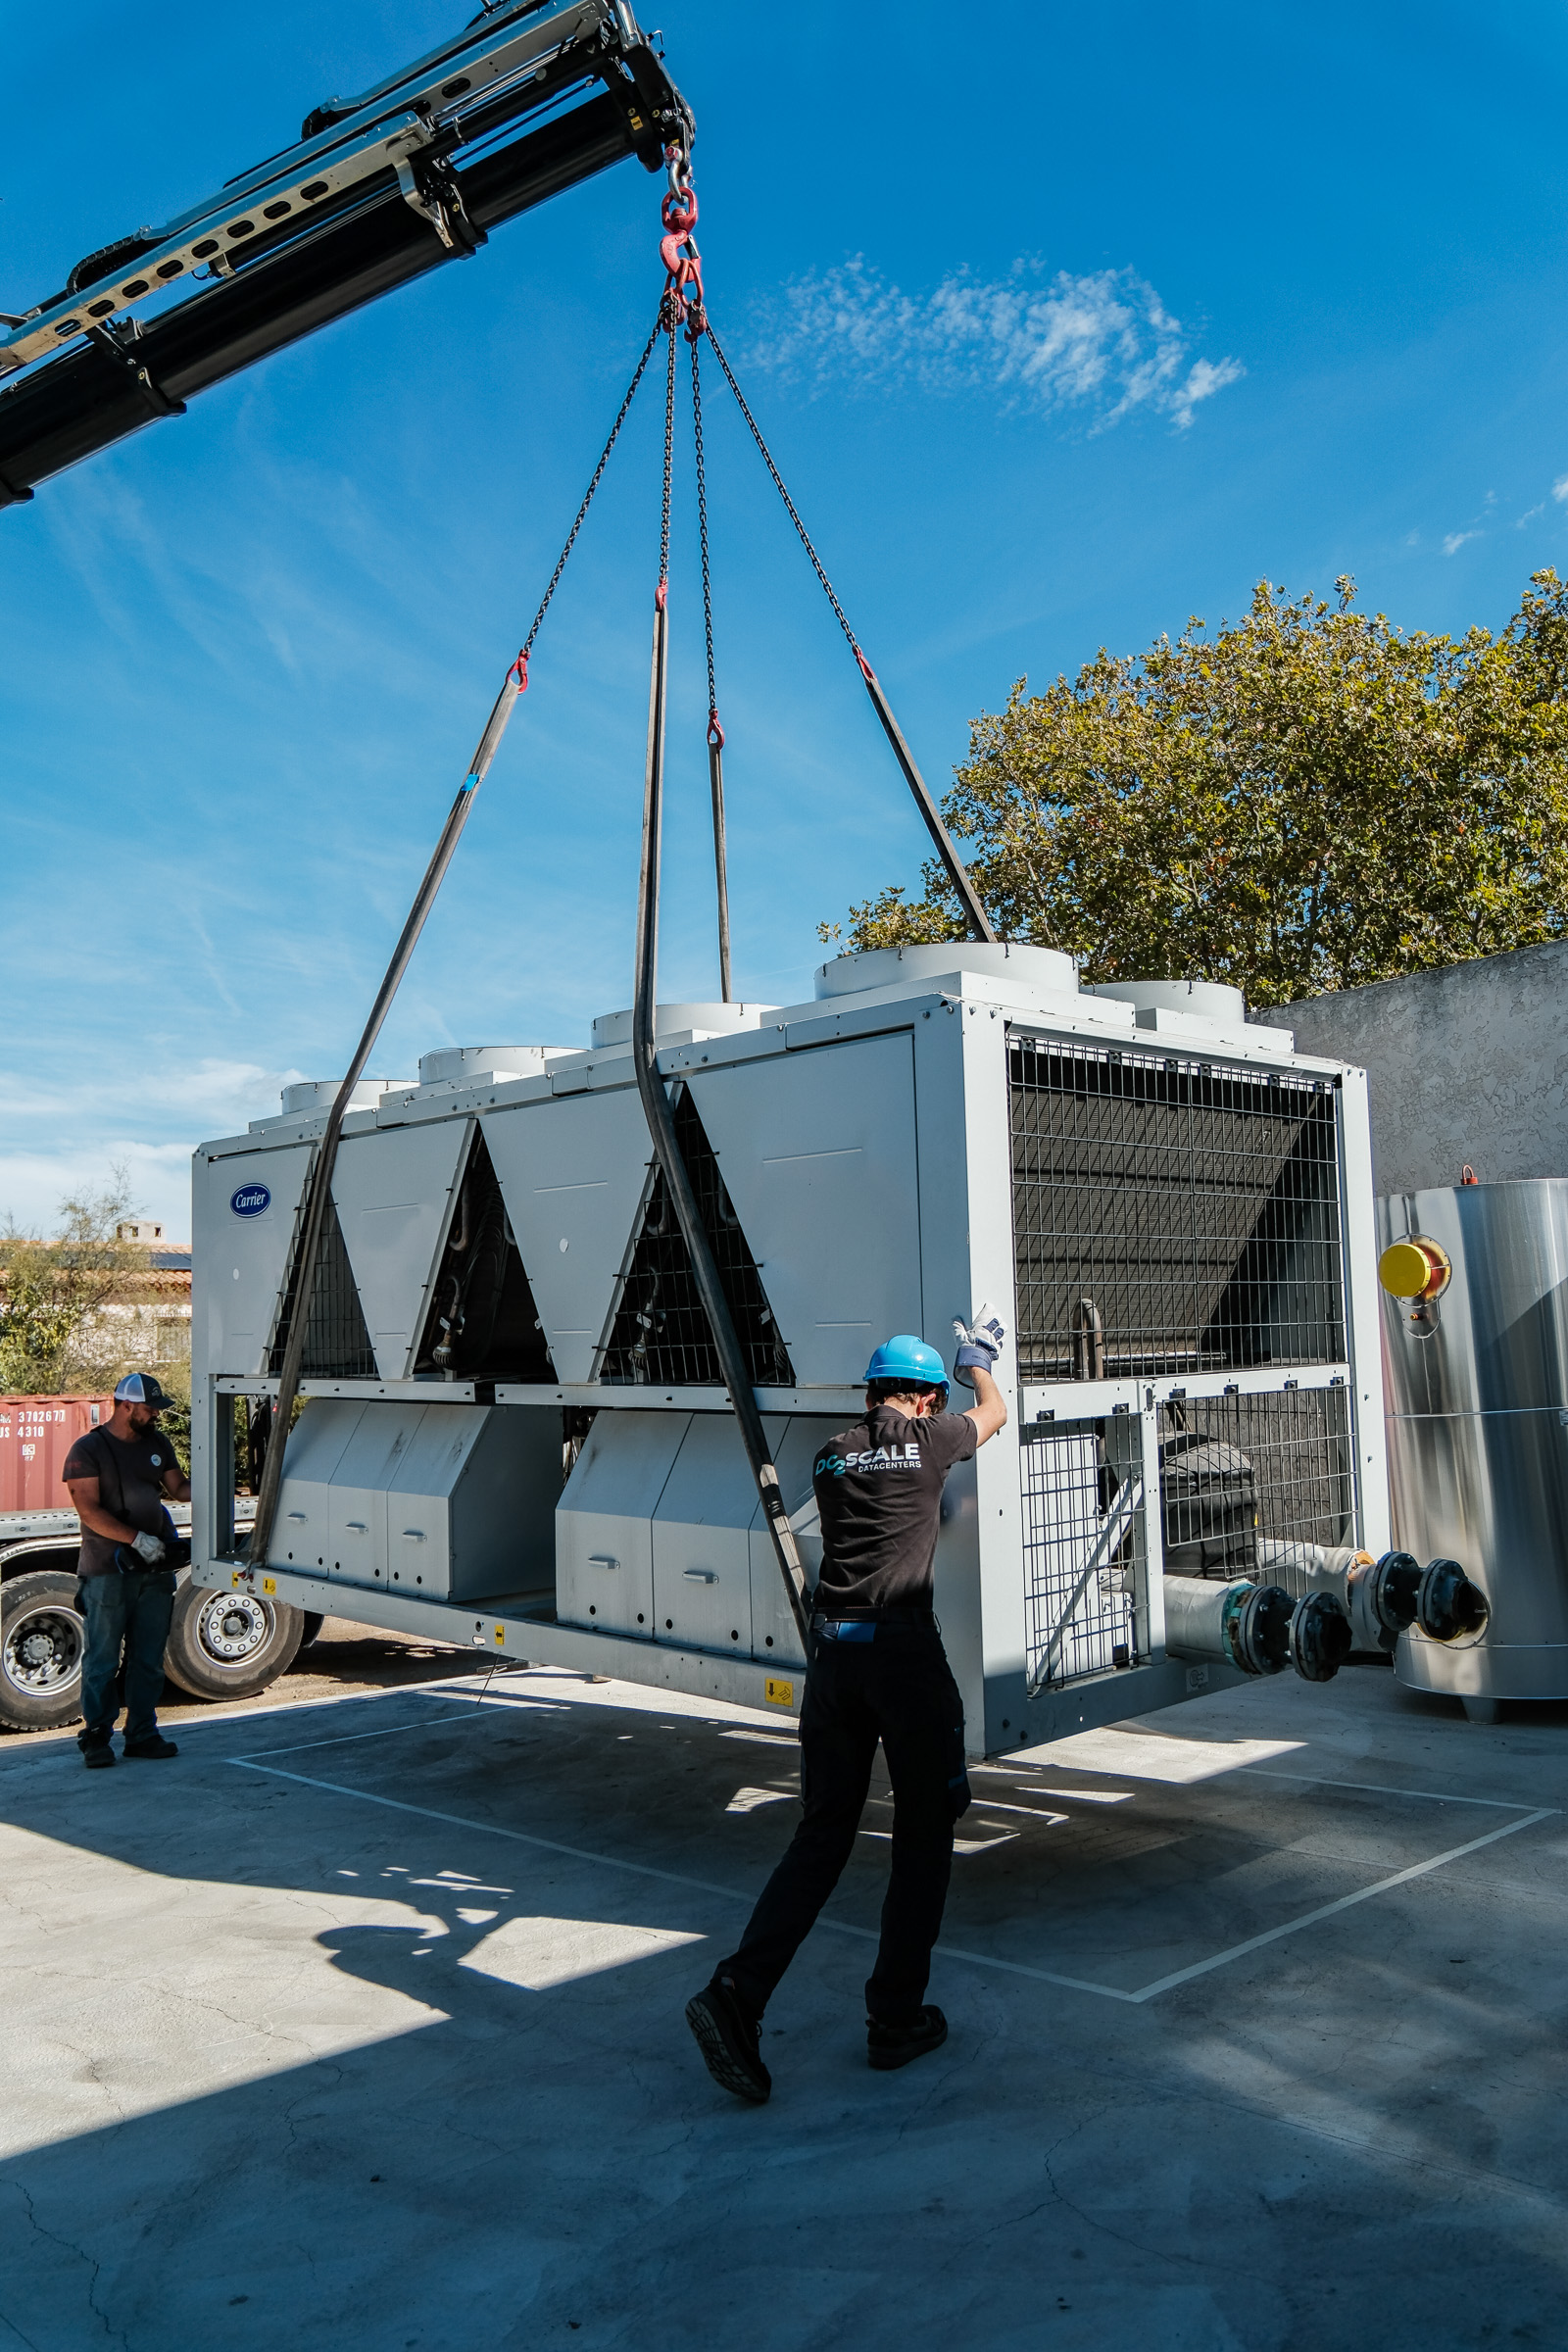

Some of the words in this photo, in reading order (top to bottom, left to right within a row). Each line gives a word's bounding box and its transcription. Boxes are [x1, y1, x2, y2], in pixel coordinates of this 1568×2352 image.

[235, 1192, 266, 1208] Carrier
[17, 1425, 44, 1438] 4310
[858, 1460, 922, 1473] DATACENTERS
